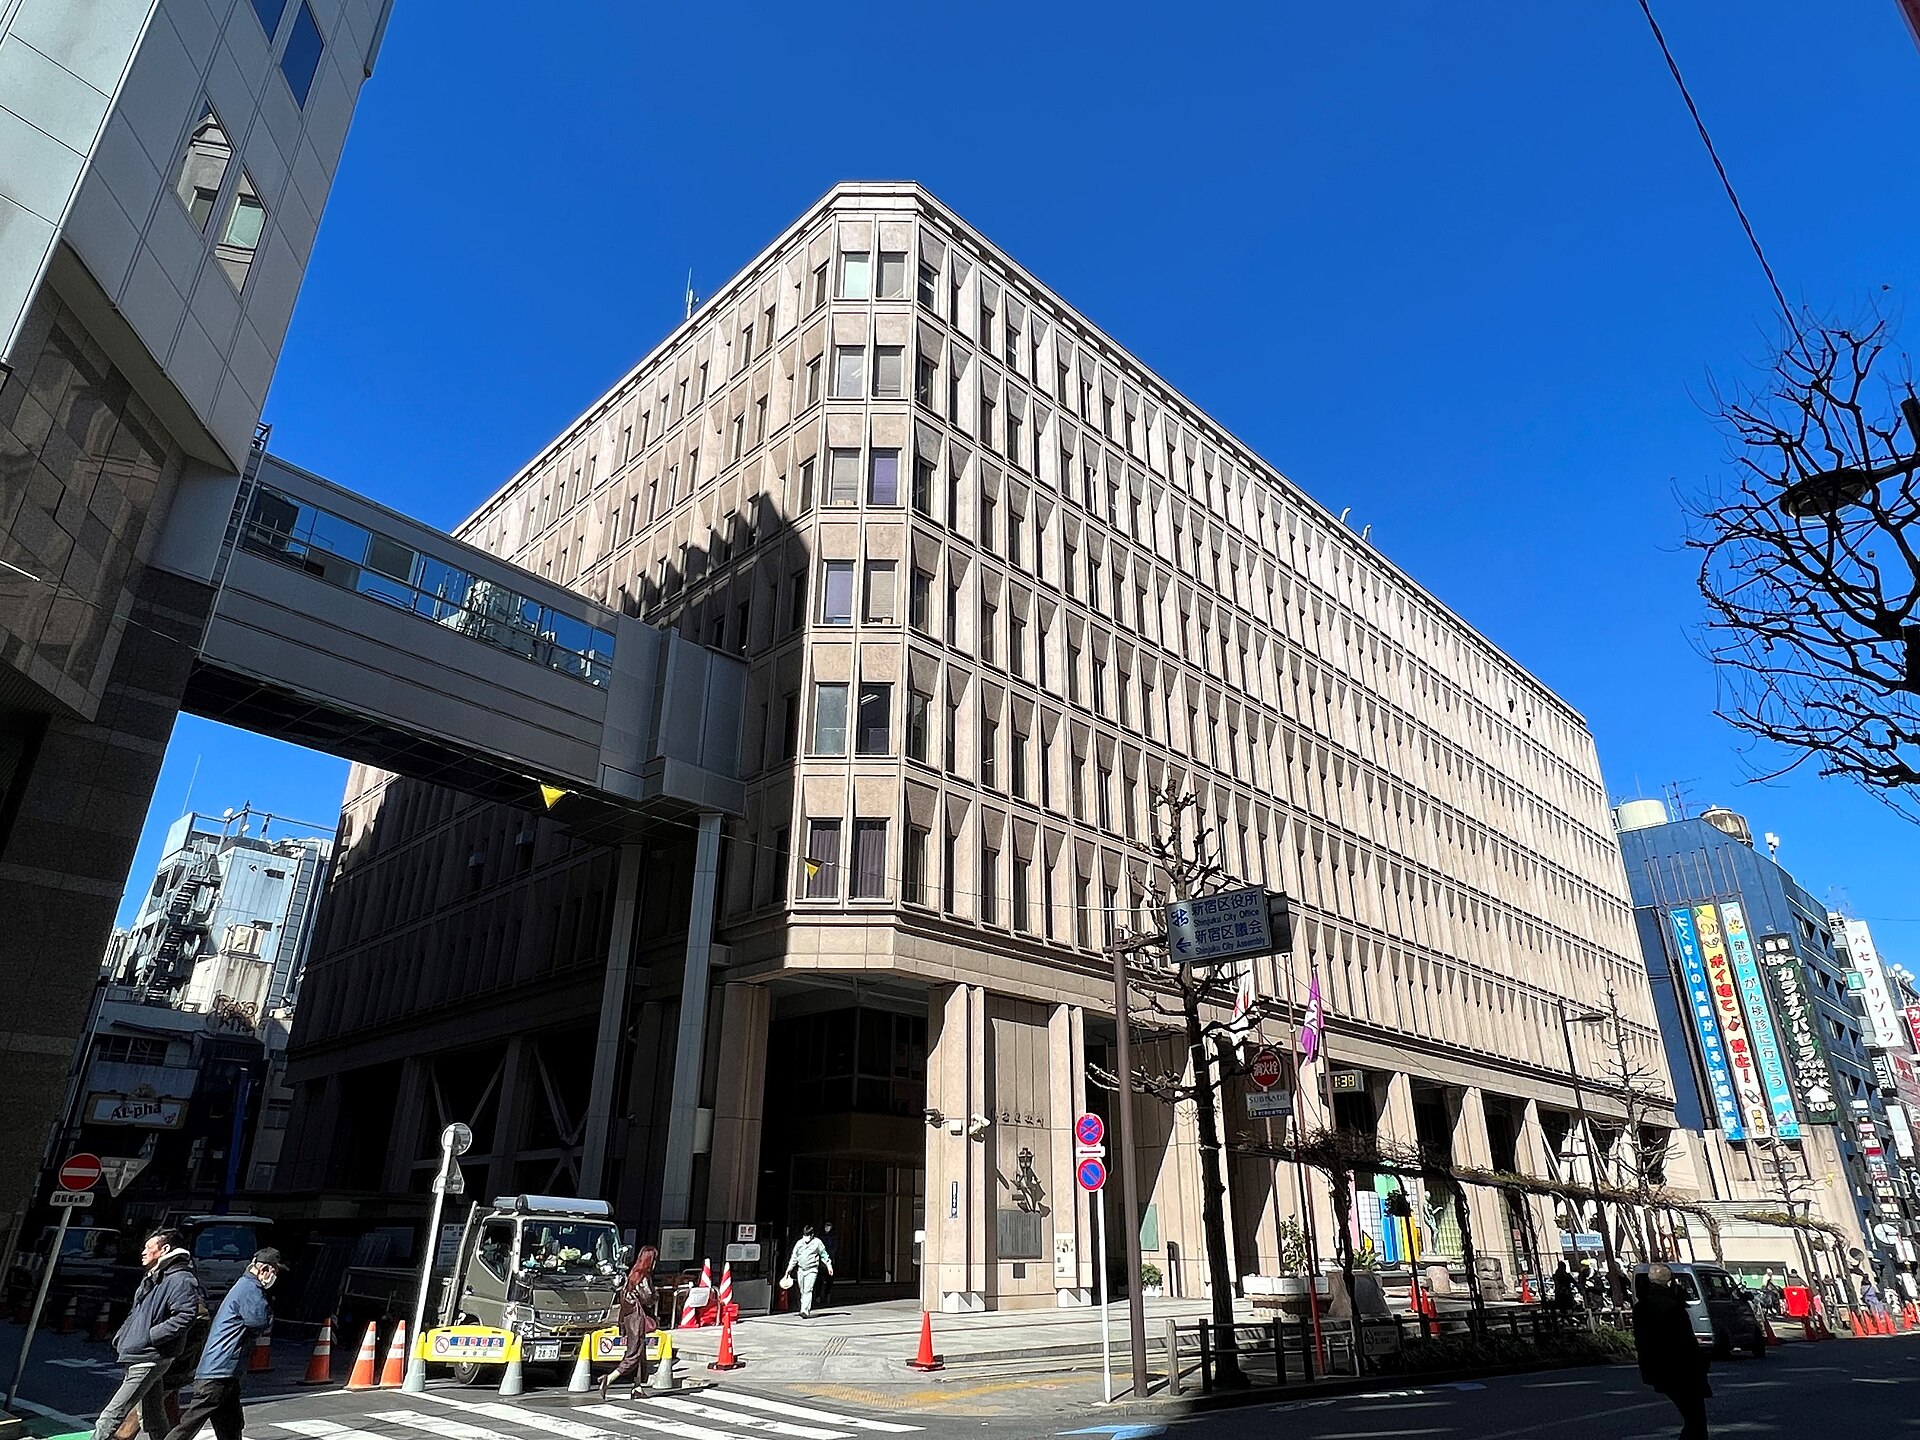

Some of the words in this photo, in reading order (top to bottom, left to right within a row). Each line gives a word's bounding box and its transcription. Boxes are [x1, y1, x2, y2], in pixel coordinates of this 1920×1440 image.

[1191, 891, 1258, 916] 新宿区役所
[1223, 913, 1237, 922] City
[1239, 908, 1260, 919] Office
[1194, 919, 1263, 944] 新宿区議会
[1222, 941, 1235, 950] City
[1854, 935, 1893, 1041] パセラリゾーツ
[1778, 966, 1816, 1061] カラオケパセラ
[1253, 1060, 1279, 1077] 消火栓
[1334, 1074, 1355, 1088] 1:38
[1871, 1056, 1892, 1090] THEATRE
